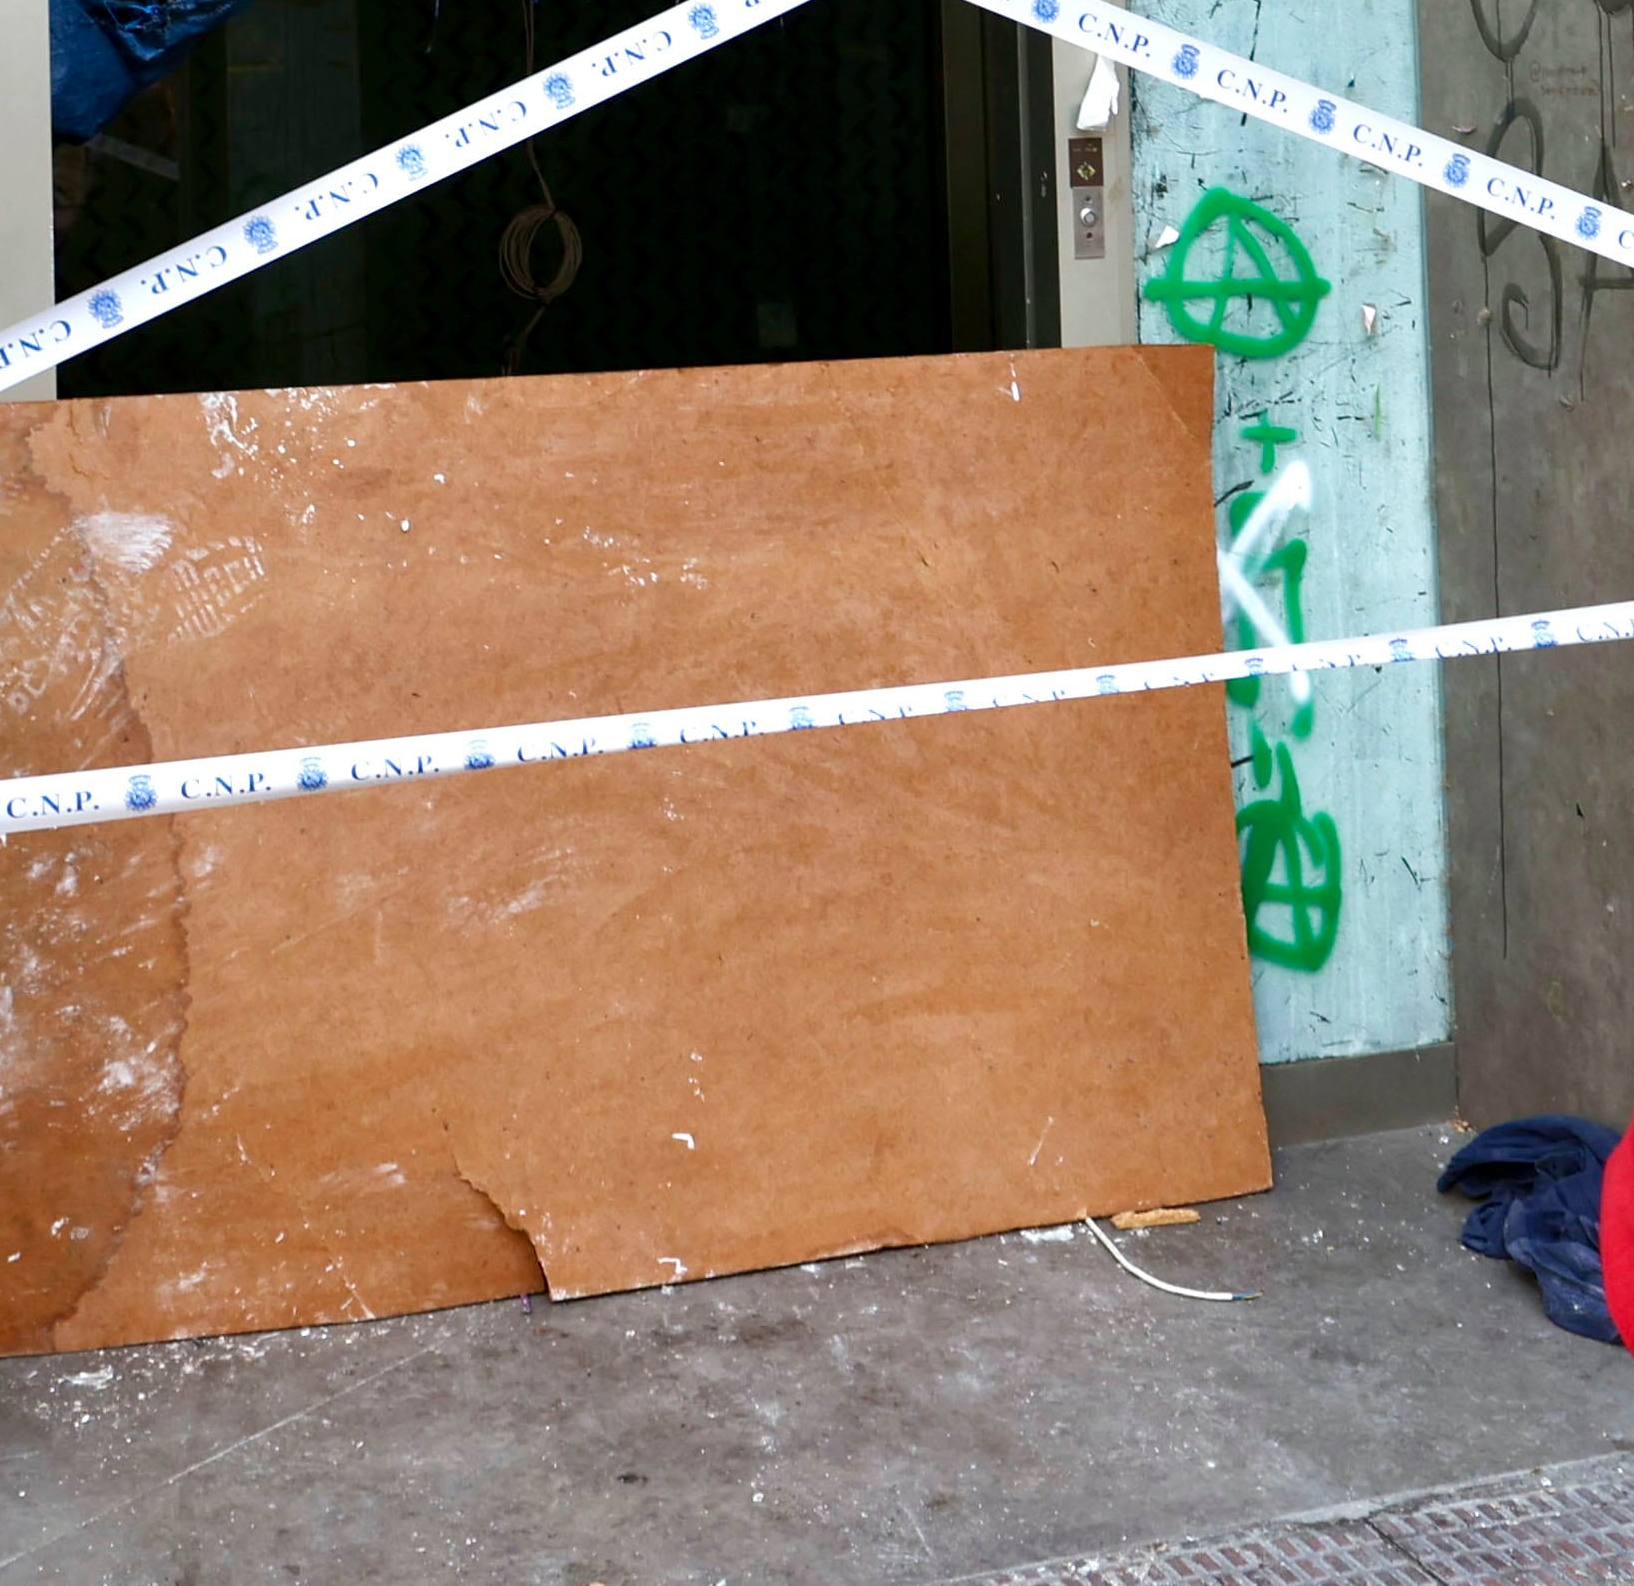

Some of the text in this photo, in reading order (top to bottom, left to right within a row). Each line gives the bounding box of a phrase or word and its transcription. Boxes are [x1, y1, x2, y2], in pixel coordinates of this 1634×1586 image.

[591, 30, 672, 78] C.N.P.
[446, 101, 528, 149] C.N.P.
[1077, 13, 1150, 58] C.N.P.
[1216, 69, 1288, 113] C.N.P.
[1352, 124, 1423, 167] C.N.P.
[1486, 177, 1554, 219] C.N.P.
[293, 173, 379, 221] C.N.P.
[141, 245, 227, 295] C.N.P.
[5, 791, 101, 820] C.N.P.
